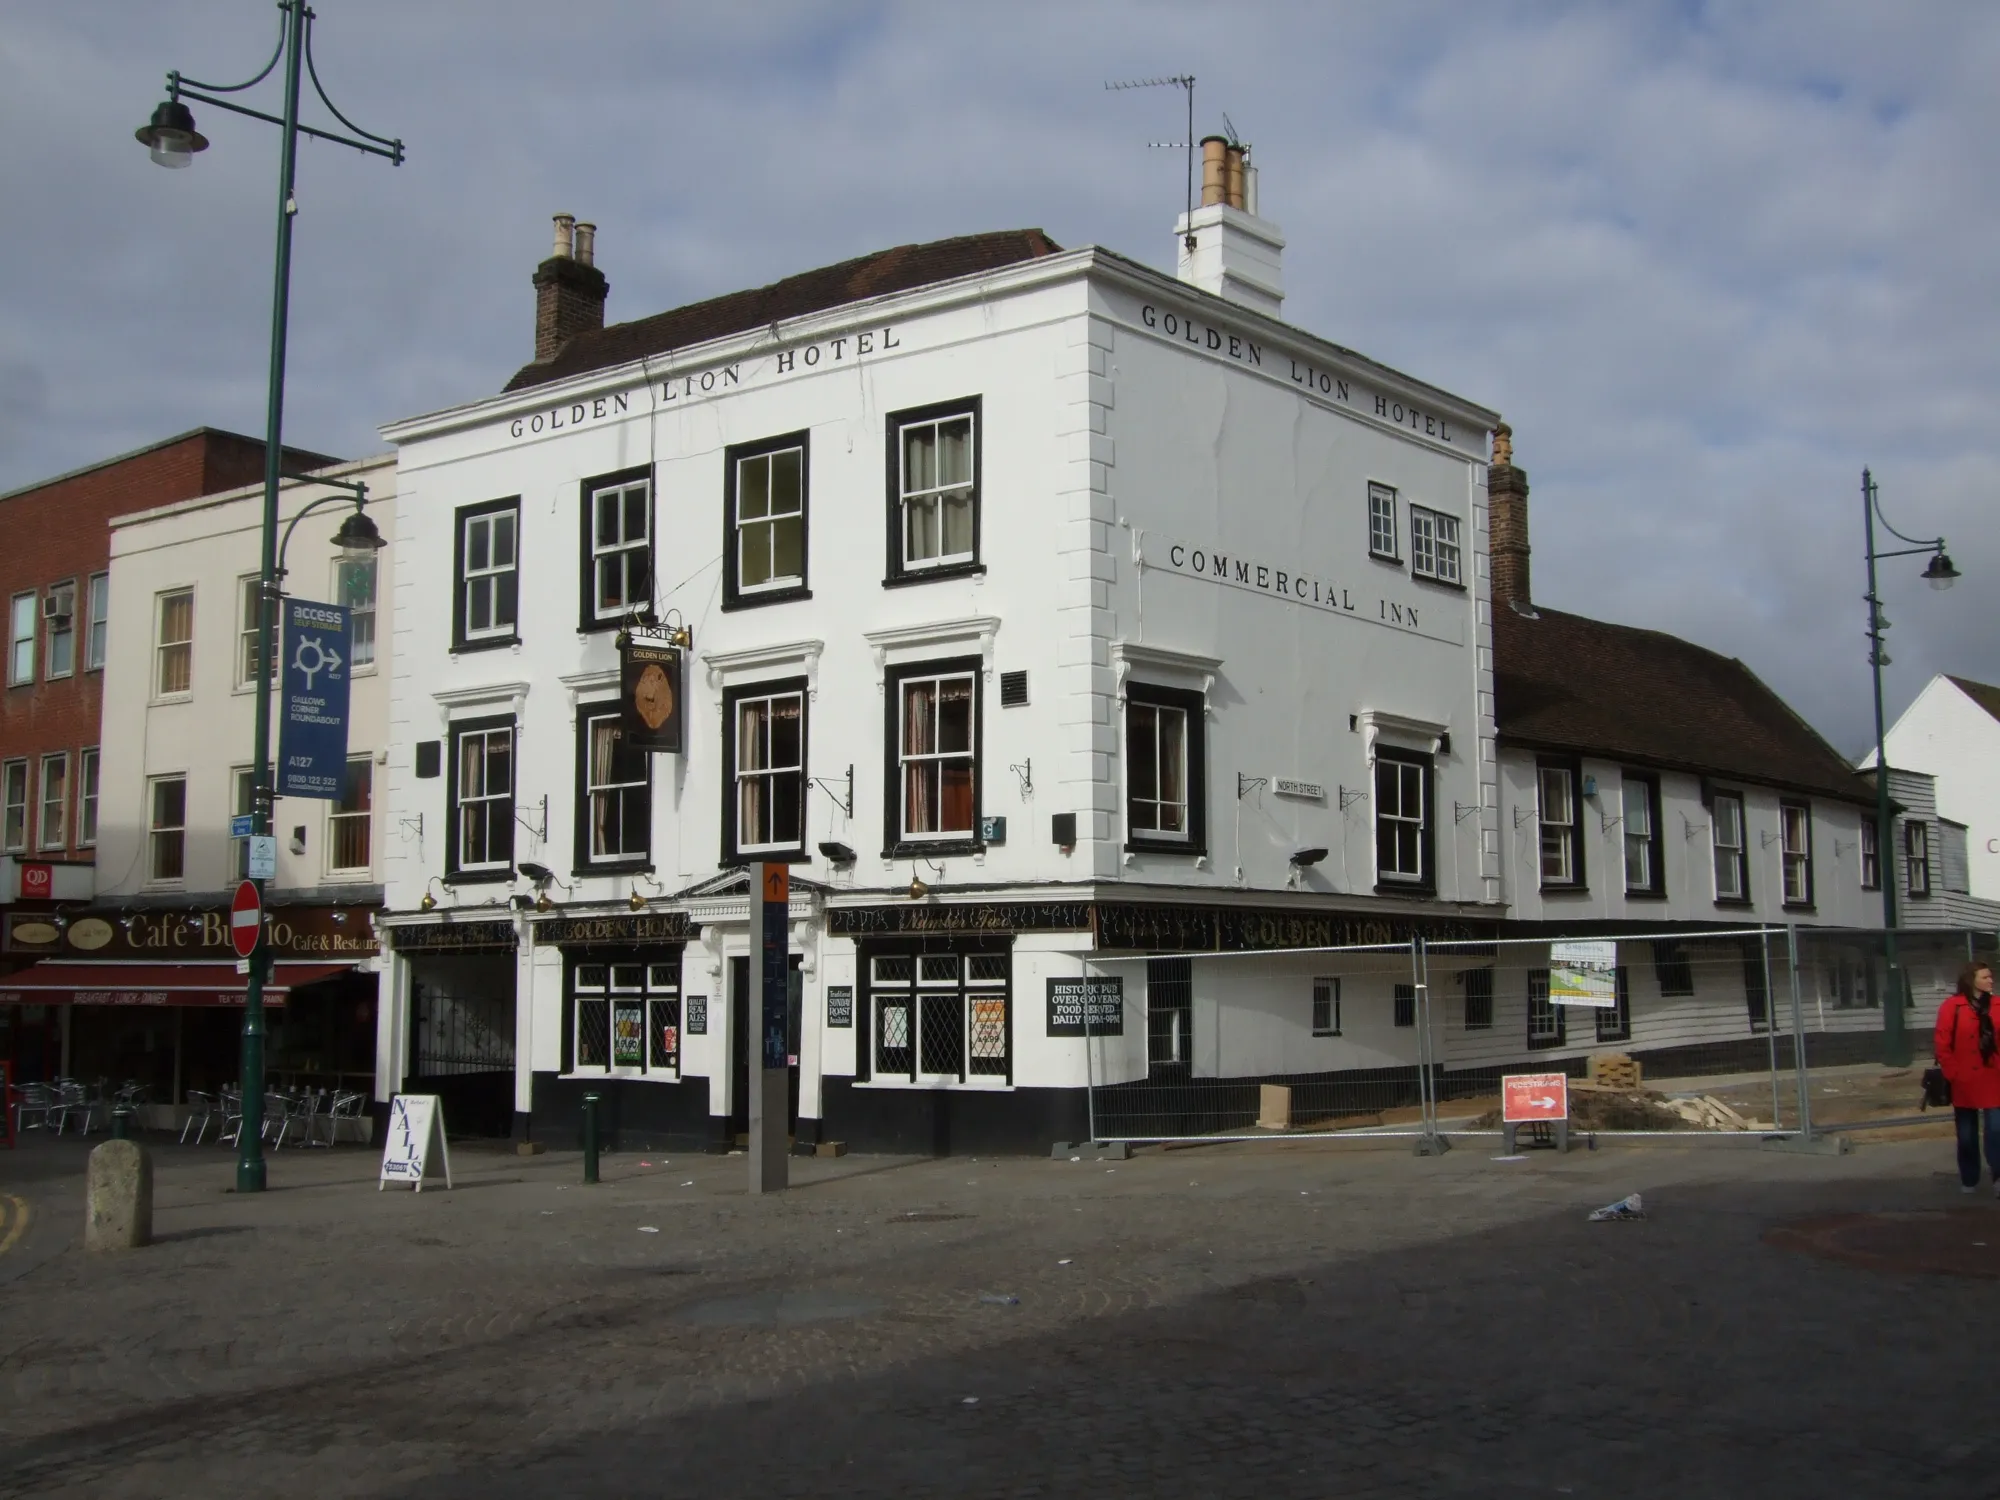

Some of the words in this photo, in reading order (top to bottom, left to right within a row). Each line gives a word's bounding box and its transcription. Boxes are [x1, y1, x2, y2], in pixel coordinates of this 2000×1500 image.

[1142, 305, 1262, 366] GOLDEN
[1291, 361, 1350, 402] LION
[1375, 396, 1451, 441] HOTEL
[511, 392, 629, 438] GOLDEN
[663, 364, 740, 402] LION
[777, 328, 900, 374] HOTEL
[1170, 545, 1355, 611] COMMERCIAL
[1380, 600, 1419, 628] INN
[293, 606, 342, 624] access
[633, 650, 657, 659] GOLDEN
[658, 653, 673, 661] LION
[291, 696, 325, 706] GALLOWS
[291, 704, 319, 714] CORNER
[290, 713, 340, 725] ROUNDABOUT
[288, 756, 312, 768] A127
[1277, 780, 1297, 791] NORTH
[1299, 784, 1321, 795] STREET
[26, 869, 48, 886] QD
[127, 913, 188, 948] Café
[563, 920, 628, 940] GOLDEN
[636, 918, 674, 938] LION
[1243, 914, 1331, 946] GOLDEN
[1345, 920, 1392, 946] LION
[293, 935, 318, 950] Café
[319, 934, 330, 951] &
[333, 934, 381, 950] Restaura
[1054, 985, 1100, 995] HISTORIC
[1101, 985, 1118, 994] PUB
[829, 998, 851, 1007] SUNDAY
[1052, 995, 1080, 1005] OVER
[1097, 995, 1121, 1004] YEARS
[688, 1005, 705, 1014] REAL
[829, 1007, 850, 1016] ROAST
[1056, 1005, 1082, 1014] FOOD
[689, 1013, 706, 1022] ALES
[1052, 1015, 1081, 1025] DAILY
[391, 1098, 422, 1179] NAILS
